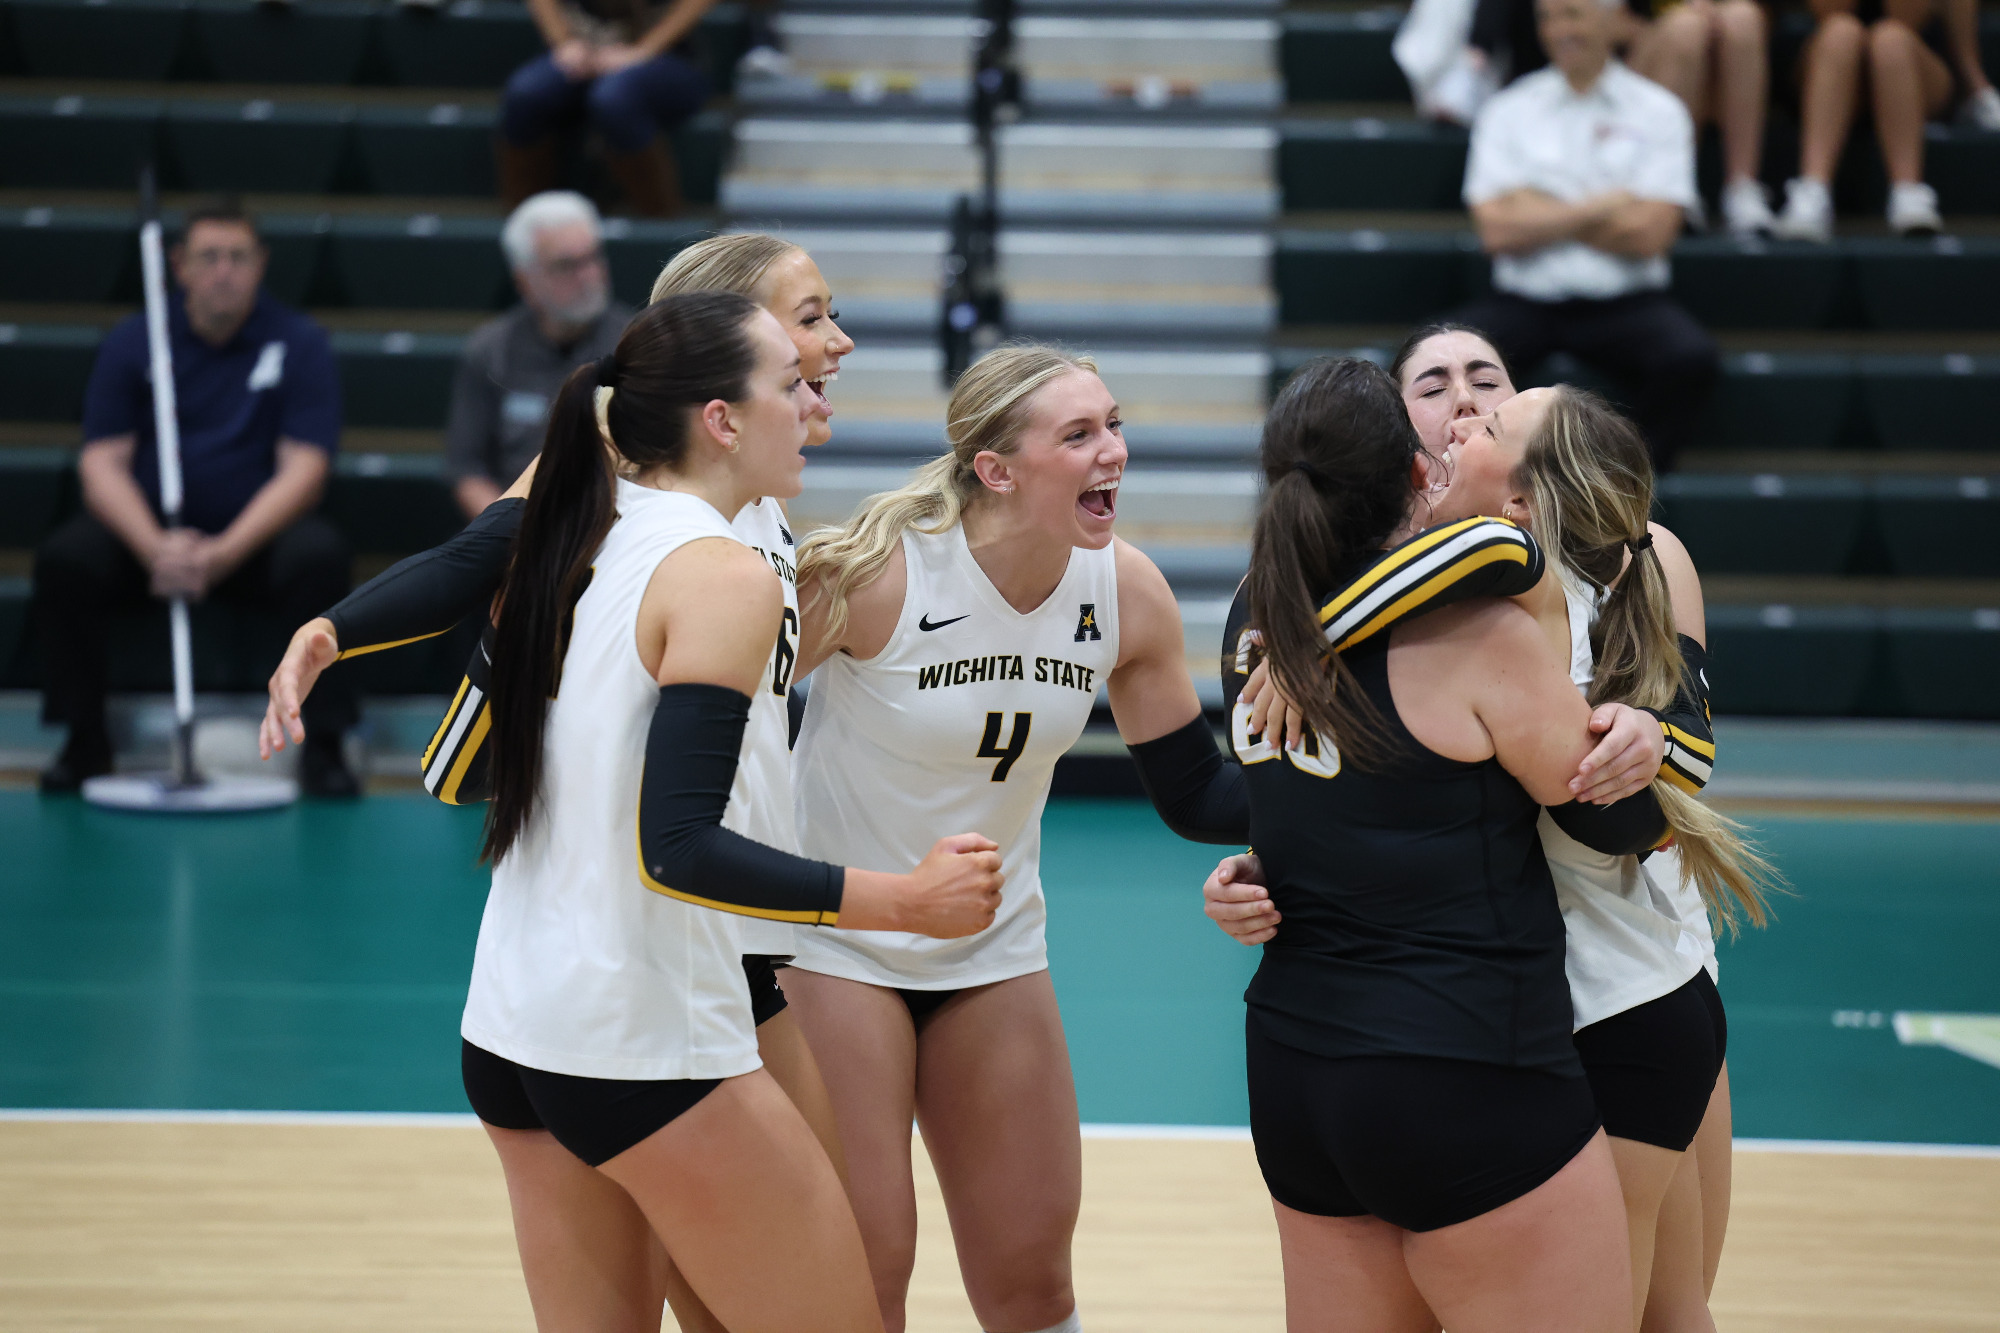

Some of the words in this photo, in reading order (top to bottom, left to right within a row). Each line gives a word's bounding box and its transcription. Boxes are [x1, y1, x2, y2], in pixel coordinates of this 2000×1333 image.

[770, 551, 797, 588] STAT
[918, 655, 1024, 690] WICHITA
[1034, 656, 1095, 693] STATE
[975, 711, 1033, 783] 4
